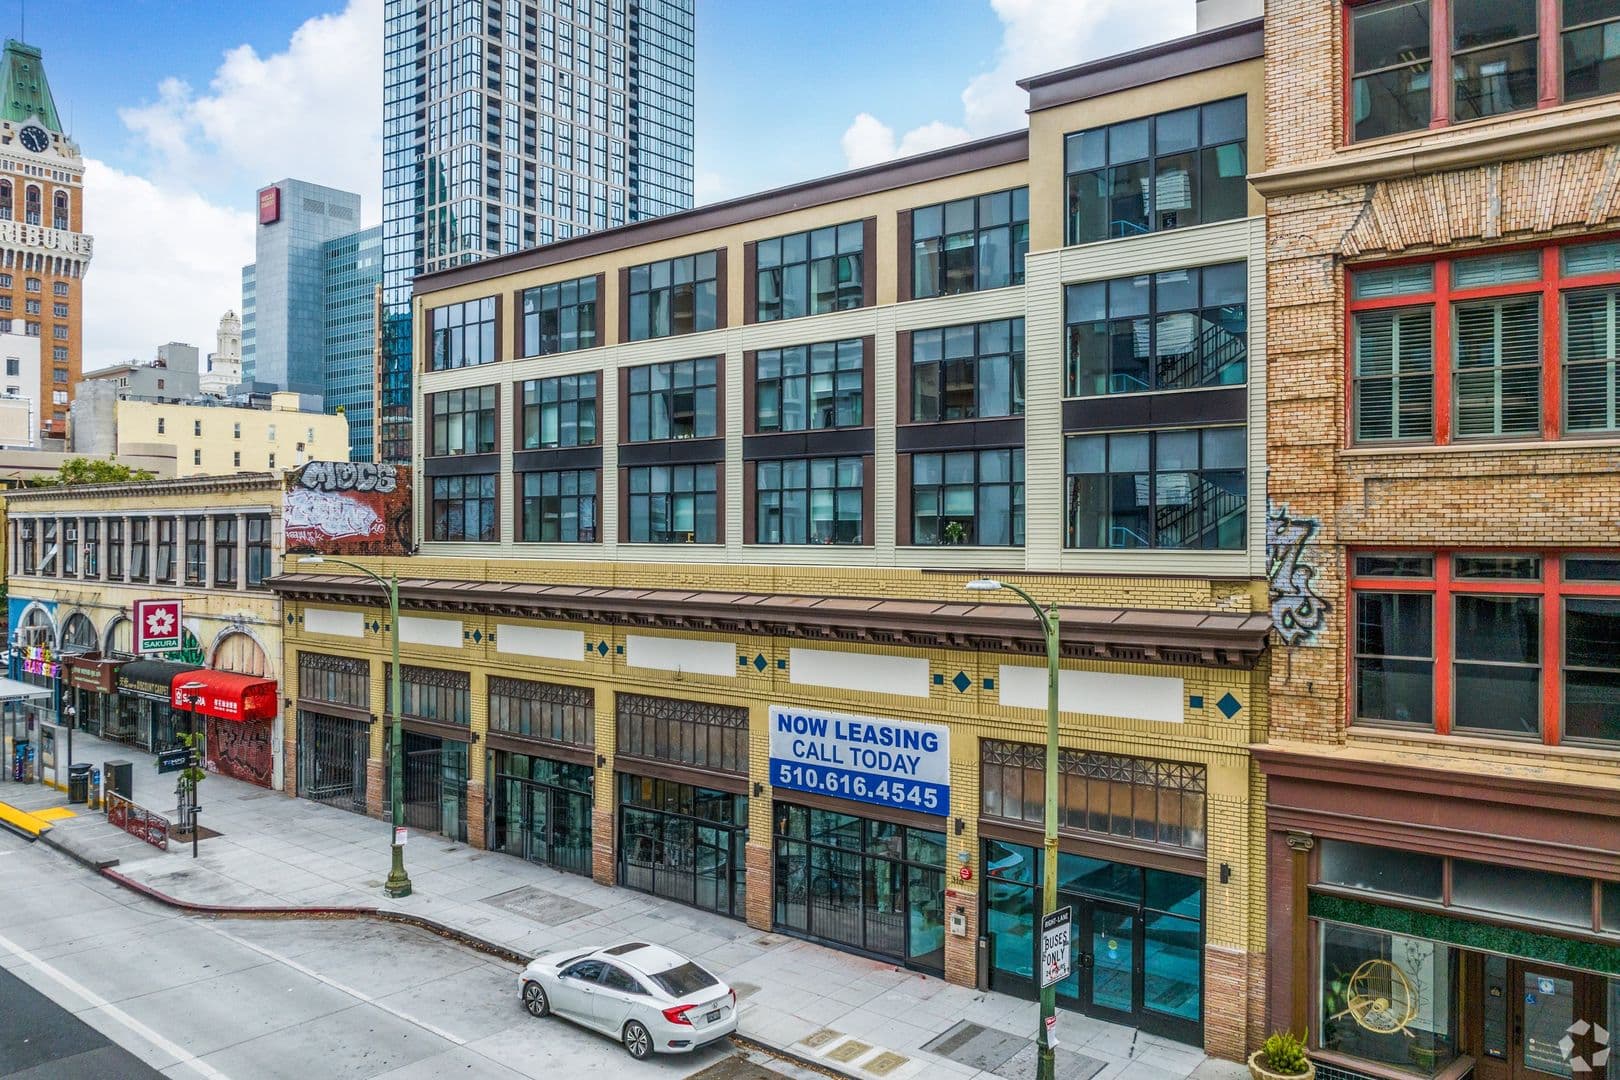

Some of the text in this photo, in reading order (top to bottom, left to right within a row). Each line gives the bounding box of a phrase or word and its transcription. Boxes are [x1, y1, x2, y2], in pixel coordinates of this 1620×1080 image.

[144, 640, 177, 648] SAKURA
[777, 714, 938, 752] NOW LEASING
[792, 739, 921, 775] CALL TODAY
[779, 765, 938, 809] 510.616.4545
[1045, 931, 1067, 951] BUSES
[1046, 948, 1065, 966] ONLY
